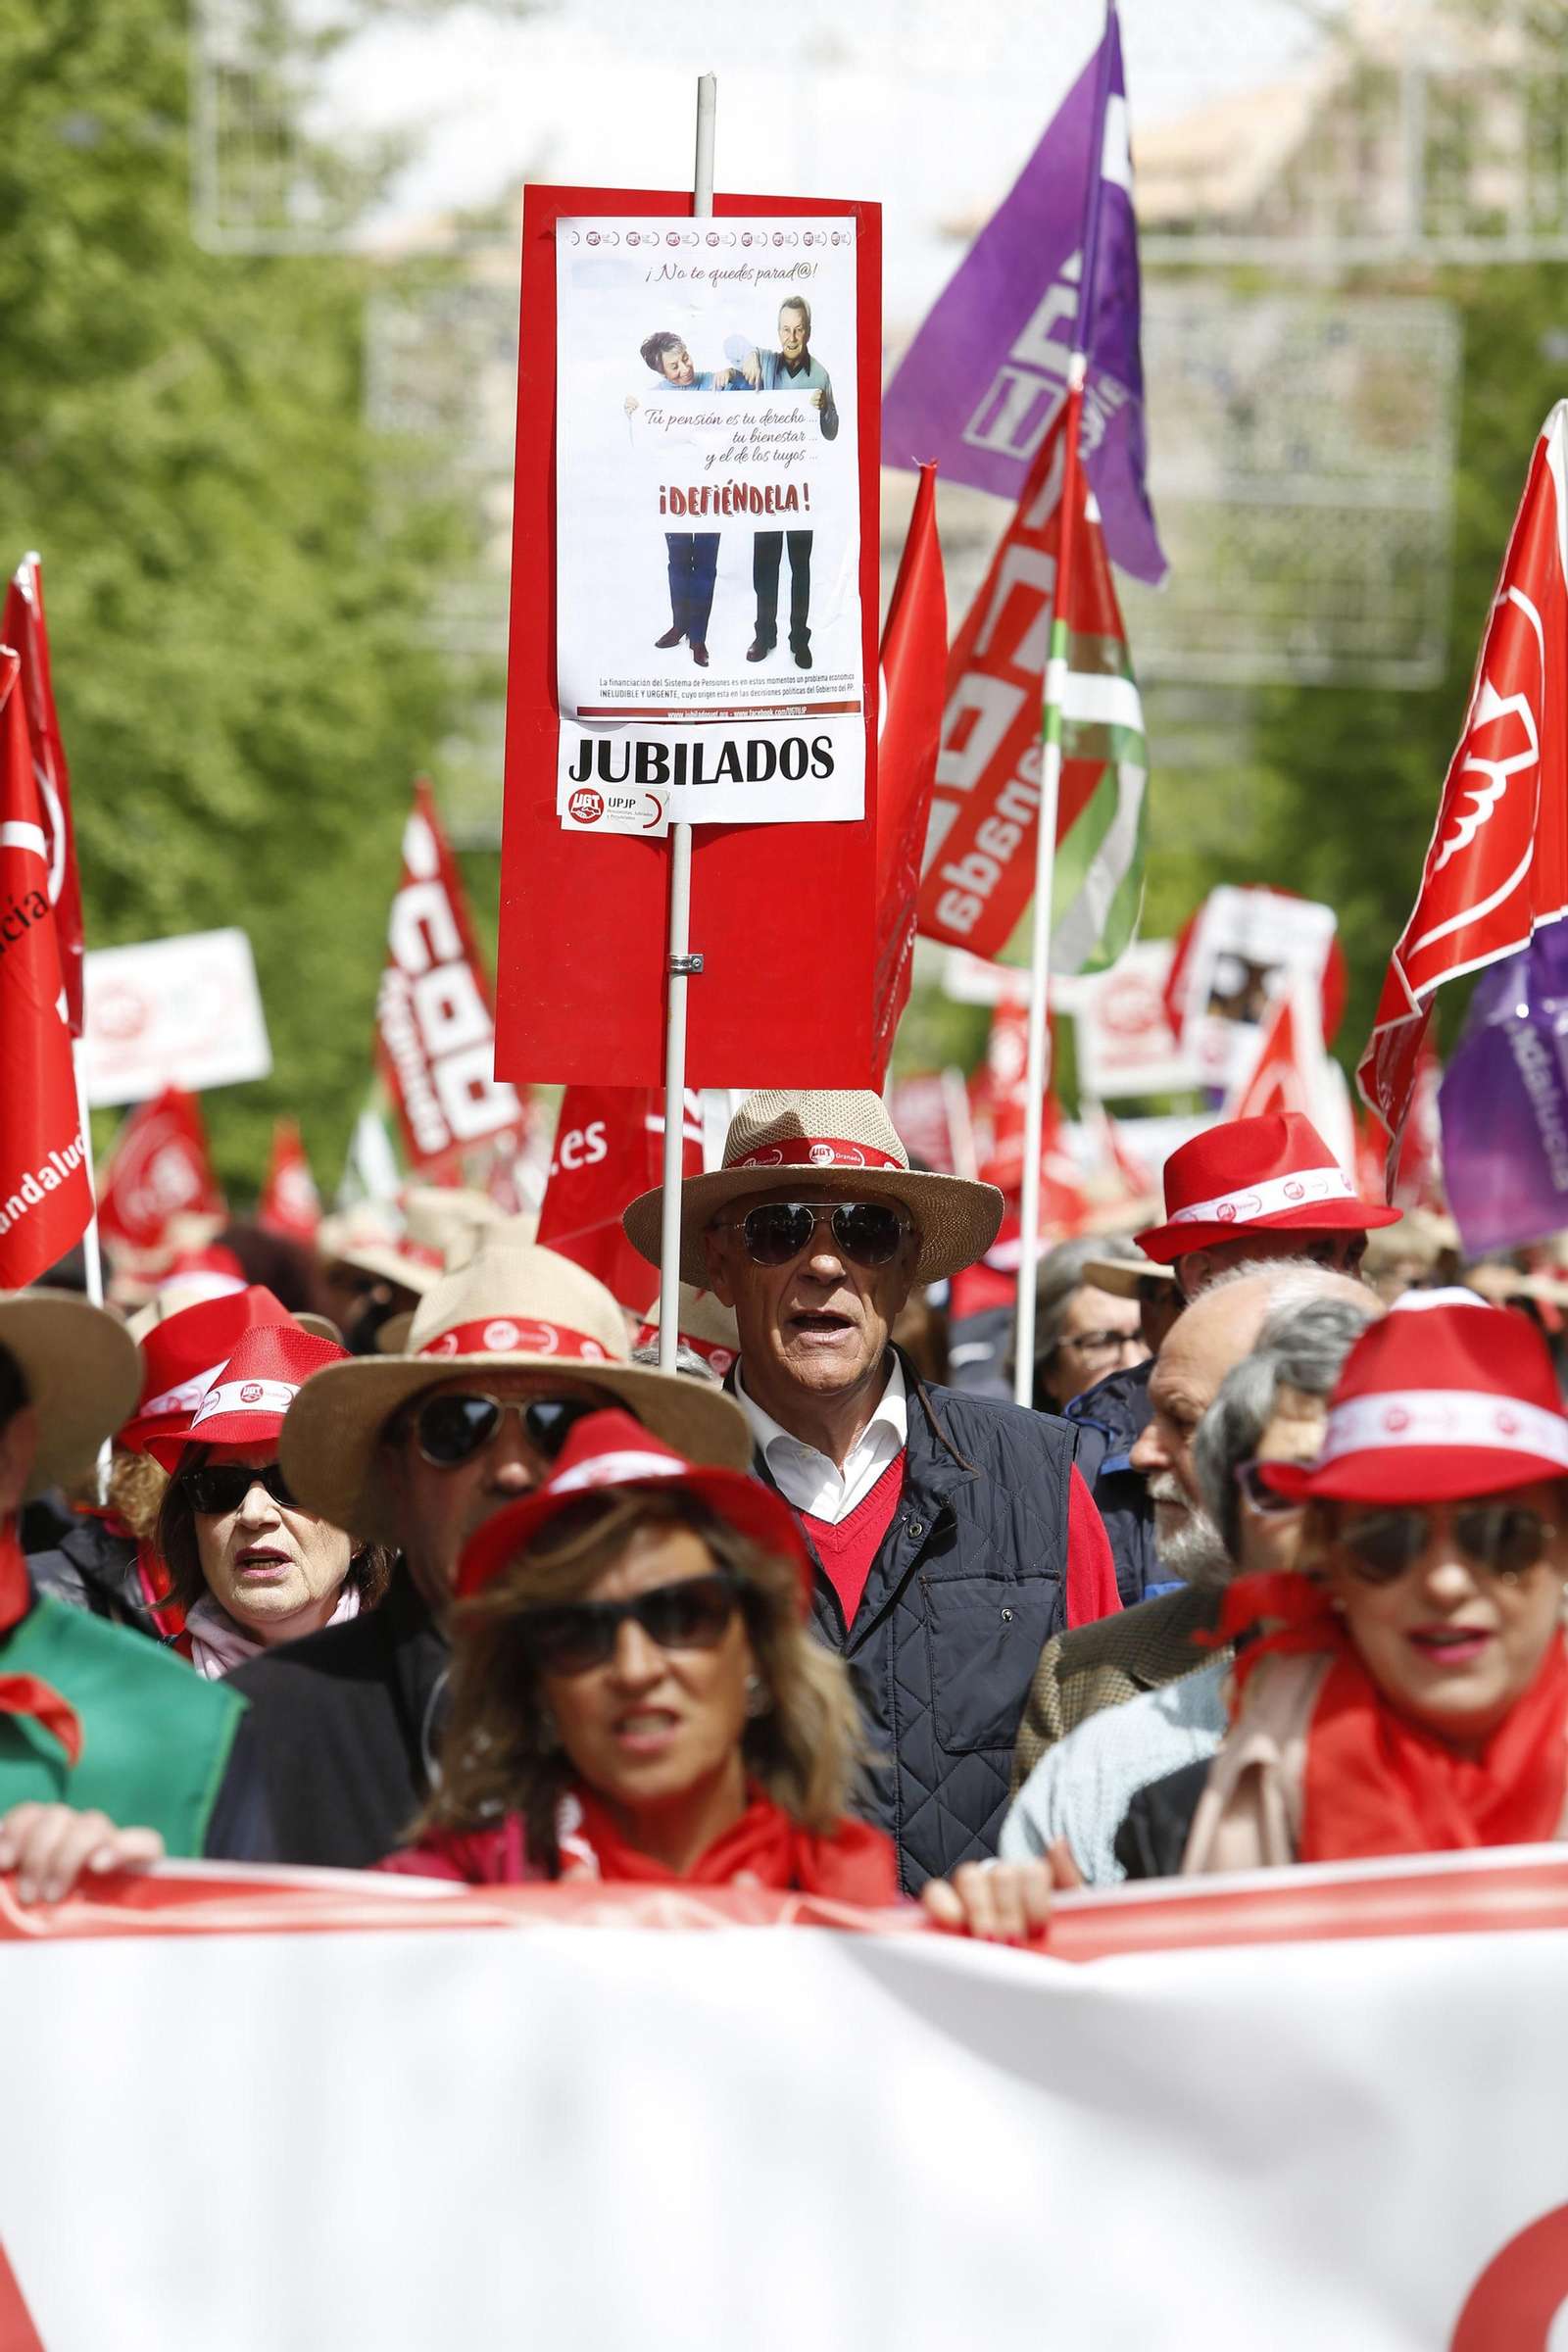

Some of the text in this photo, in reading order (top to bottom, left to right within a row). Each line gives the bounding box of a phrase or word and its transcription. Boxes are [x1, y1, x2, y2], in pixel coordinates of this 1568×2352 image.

[690, 267, 705, 279] te
[709, 263, 754, 288] quedes
[664, 412, 723, 432] pensión
[725, 413, 739, 425] es
[742, 412, 757, 425] tu
[760, 408, 806, 426] derecho
[733, 430, 747, 444] tu
[750, 427, 806, 444] bienestar
[704, 453, 716, 470] y
[718, 446, 732, 463] el
[734, 446, 749, 462] de
[752, 446, 769, 463] los
[773, 449, 807, 468] tuyos
[599, 678, 608, 687] La
[609, 678, 651, 687] financiación
[652, 678, 662, 687] del
[664, 678, 692, 687] Sistema
[693, 678, 701, 687] de
[702, 677, 730, 687] Pensiones
[766, 676, 796, 685] momentos
[805, 674, 828, 684] problema
[600, 689, 639, 698] INELUDIBLE
[640, 689, 646, 698] Y
[646, 690, 680, 700] URGENTE,
[681, 691, 697, 700] cuyo
[698, 690, 715, 700] origen
[739, 689, 750, 698] las
[750, 687, 781, 697] decisiones
[782, 686, 806, 697] políticas
[807, 685, 815, 694] del
[815, 684, 838, 694] Gobierno
[838, 683, 847, 693] del
[568, 735, 835, 785] JUBILADOS
[608, 797, 636, 809] UPJP
[812, 1147, 862, 1163] UGT Granada
